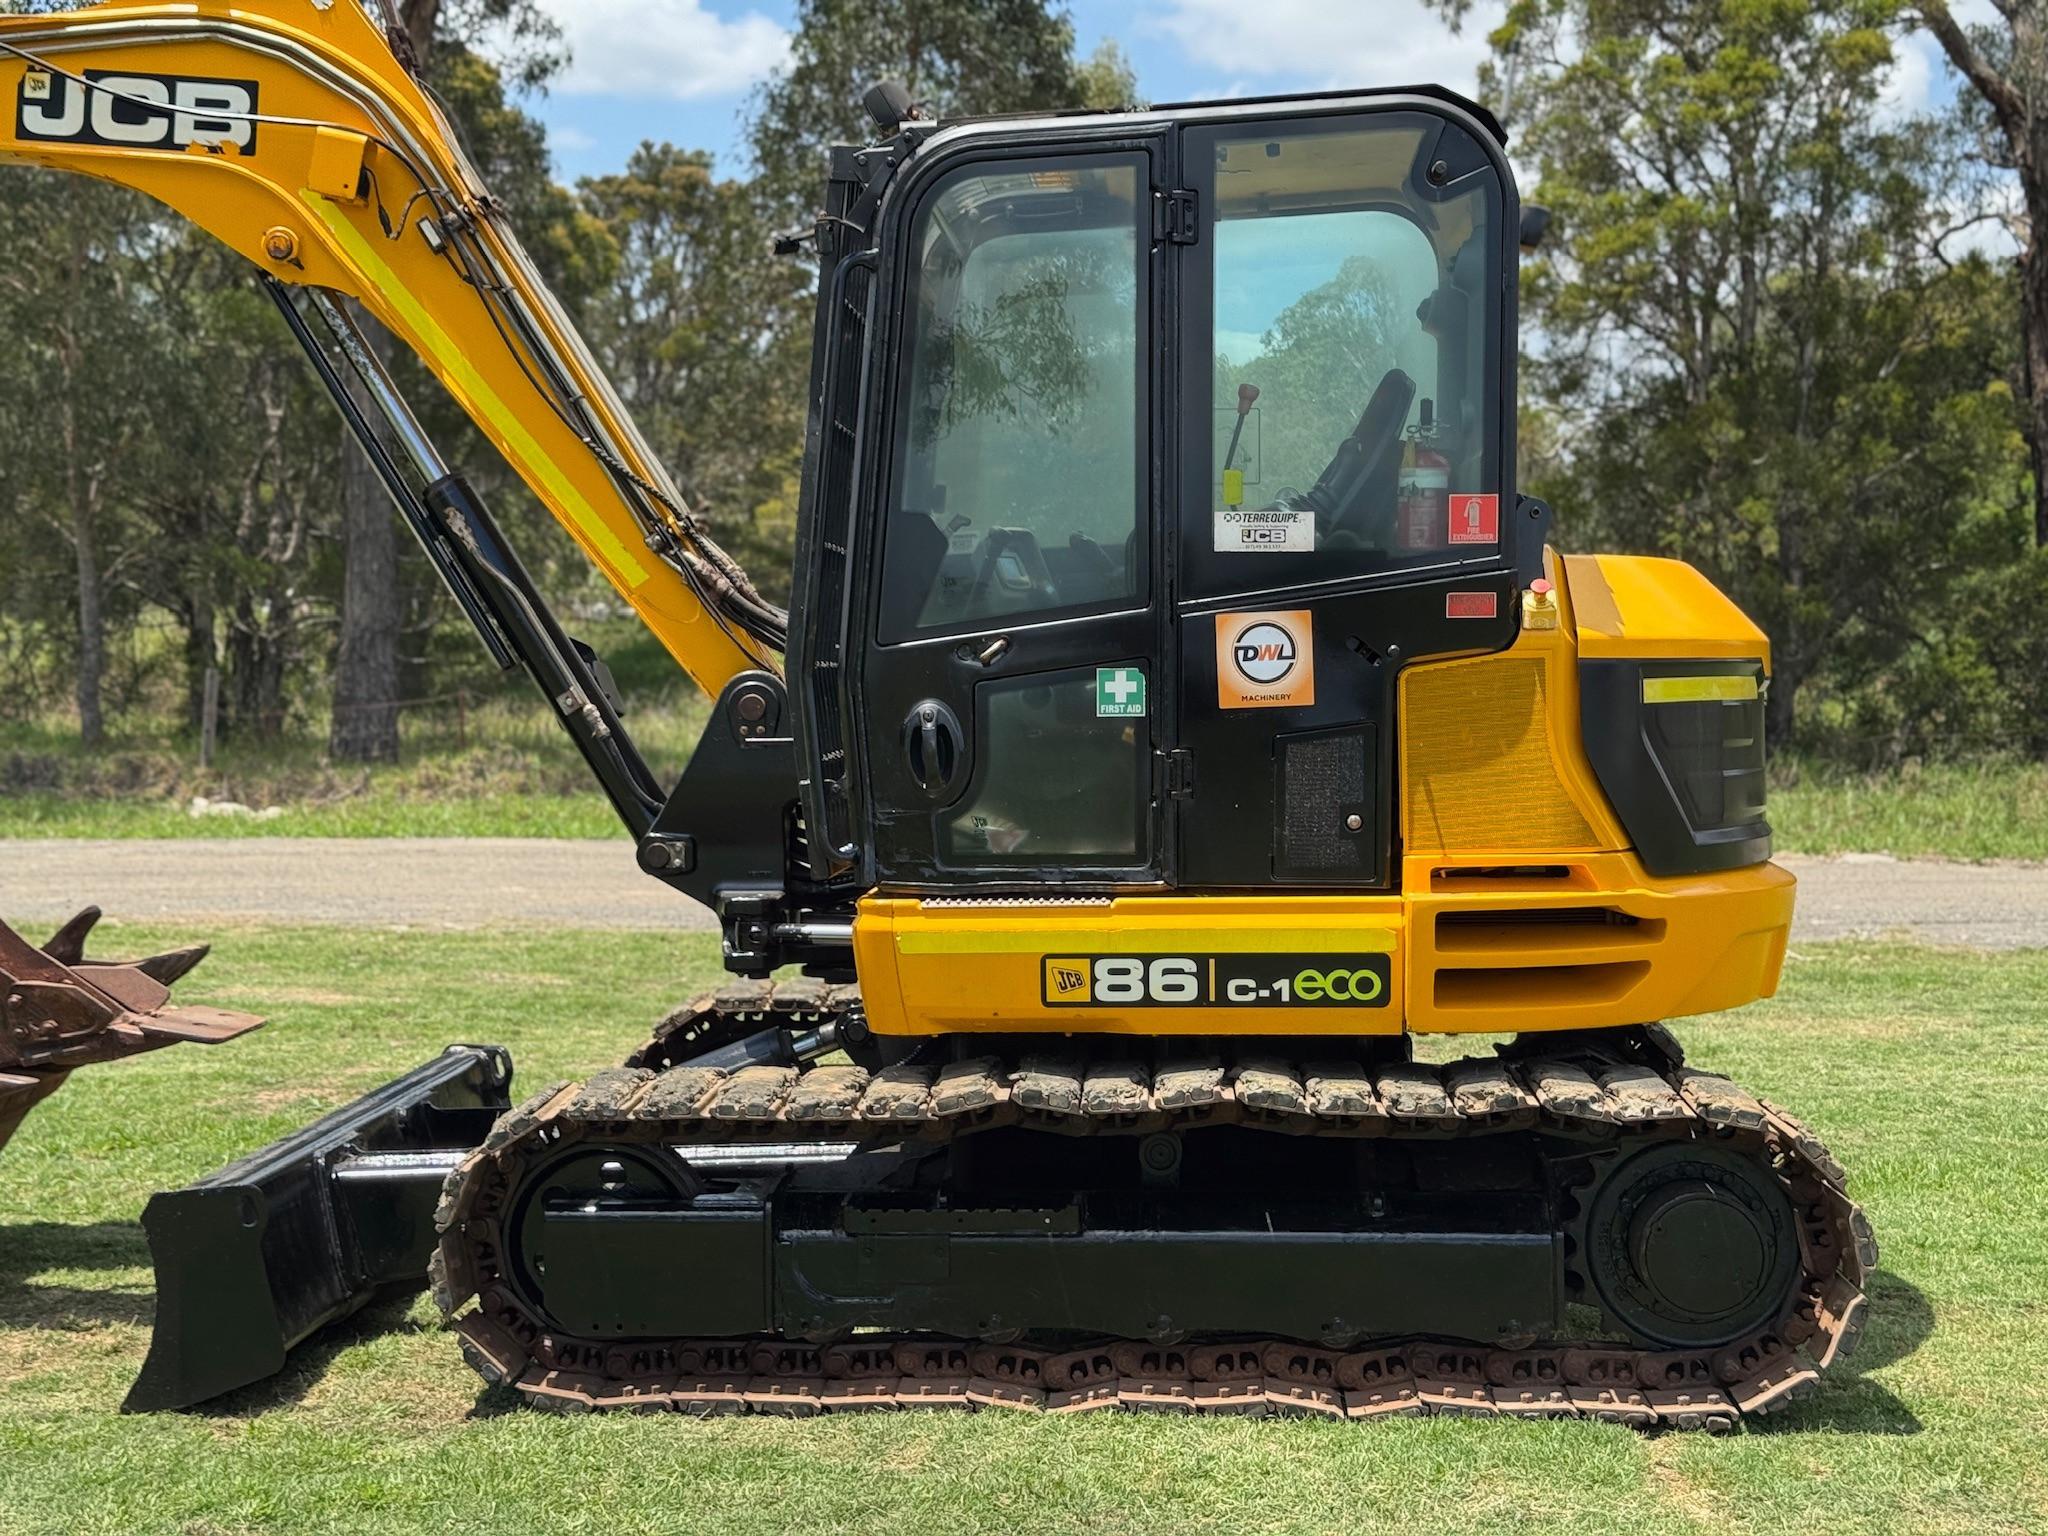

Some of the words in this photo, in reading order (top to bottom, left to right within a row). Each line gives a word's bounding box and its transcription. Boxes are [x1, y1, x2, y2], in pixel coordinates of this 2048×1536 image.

[22, 75, 251, 147] JCB
[1243, 513, 1300, 523] TERREQUIPE
[1242, 530, 1285, 543] JCB
[1453, 533, 1494, 541] EXTINGUISHER
[1235, 644, 1295, 661] DWL
[1241, 693, 1292, 702] MACHINERY
[1101, 704, 1125, 714] FIRST
[1126, 704, 1141, 714] AID
[1058, 970, 1083, 991] JCB
[1094, 958, 1199, 1002] 86
